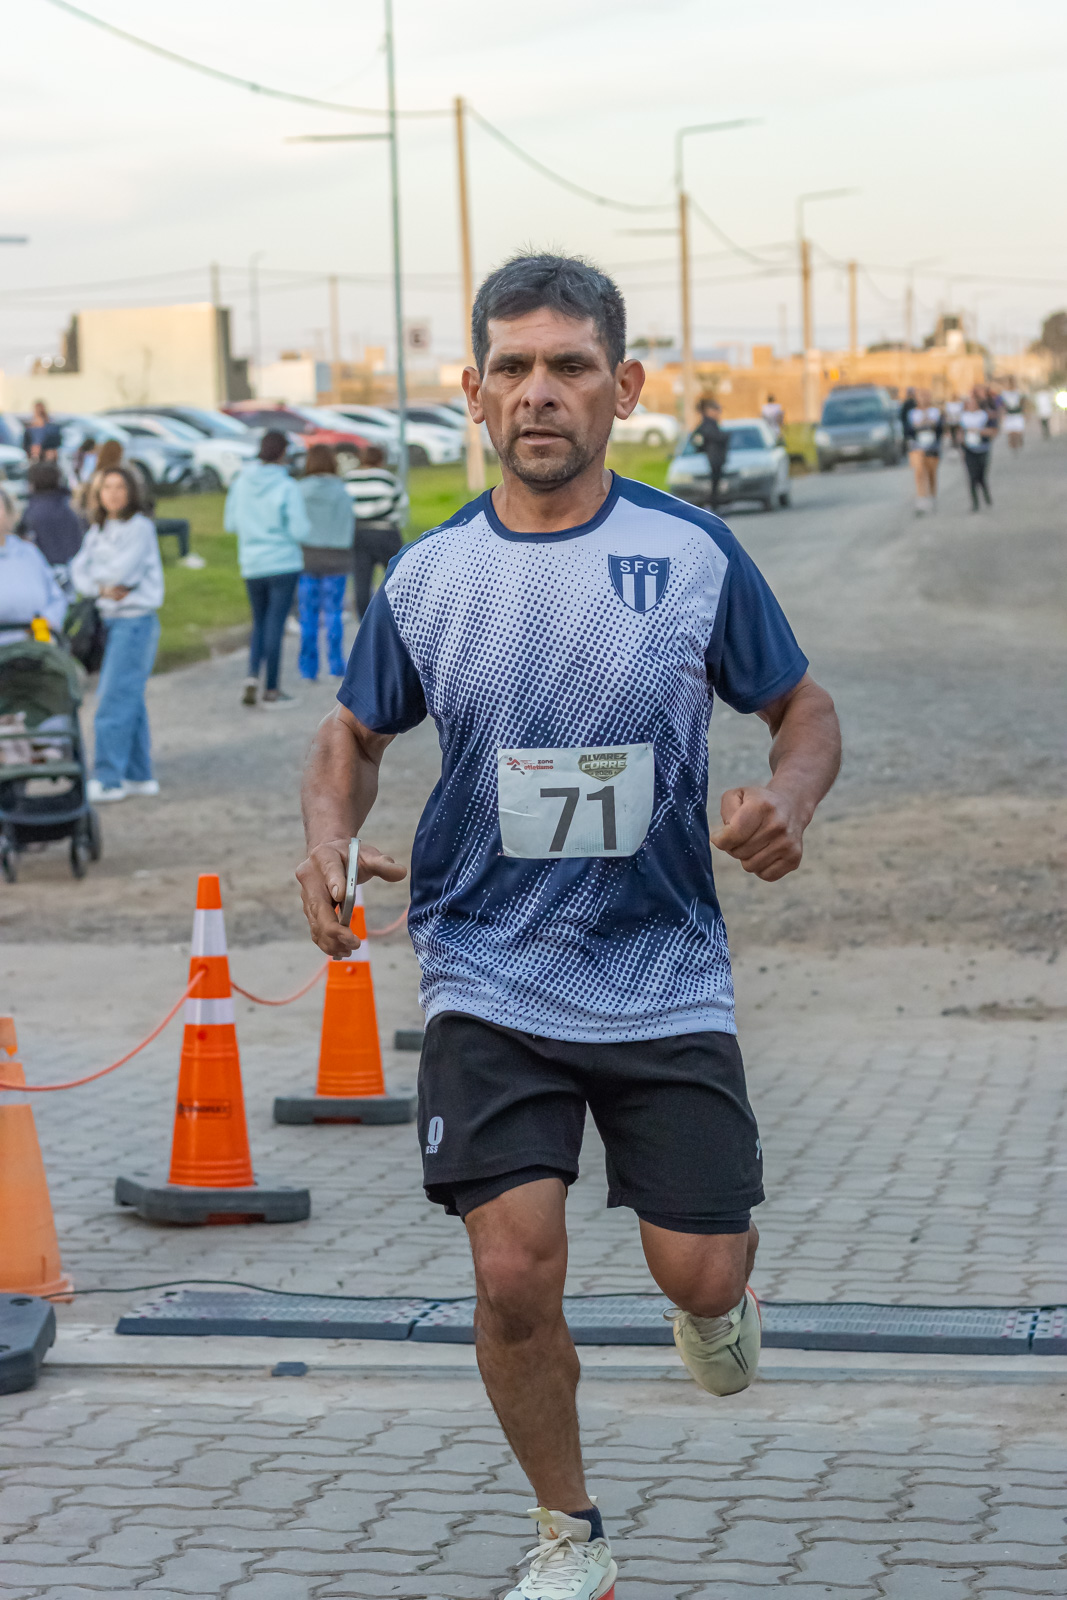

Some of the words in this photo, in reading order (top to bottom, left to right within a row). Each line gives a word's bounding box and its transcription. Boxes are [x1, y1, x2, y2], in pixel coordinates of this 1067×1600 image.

[620, 560, 659, 574] SFC
[579, 752, 628, 762] ALVAREZ
[581, 760, 626, 770] CORRE
[540, 786, 617, 852] 71
